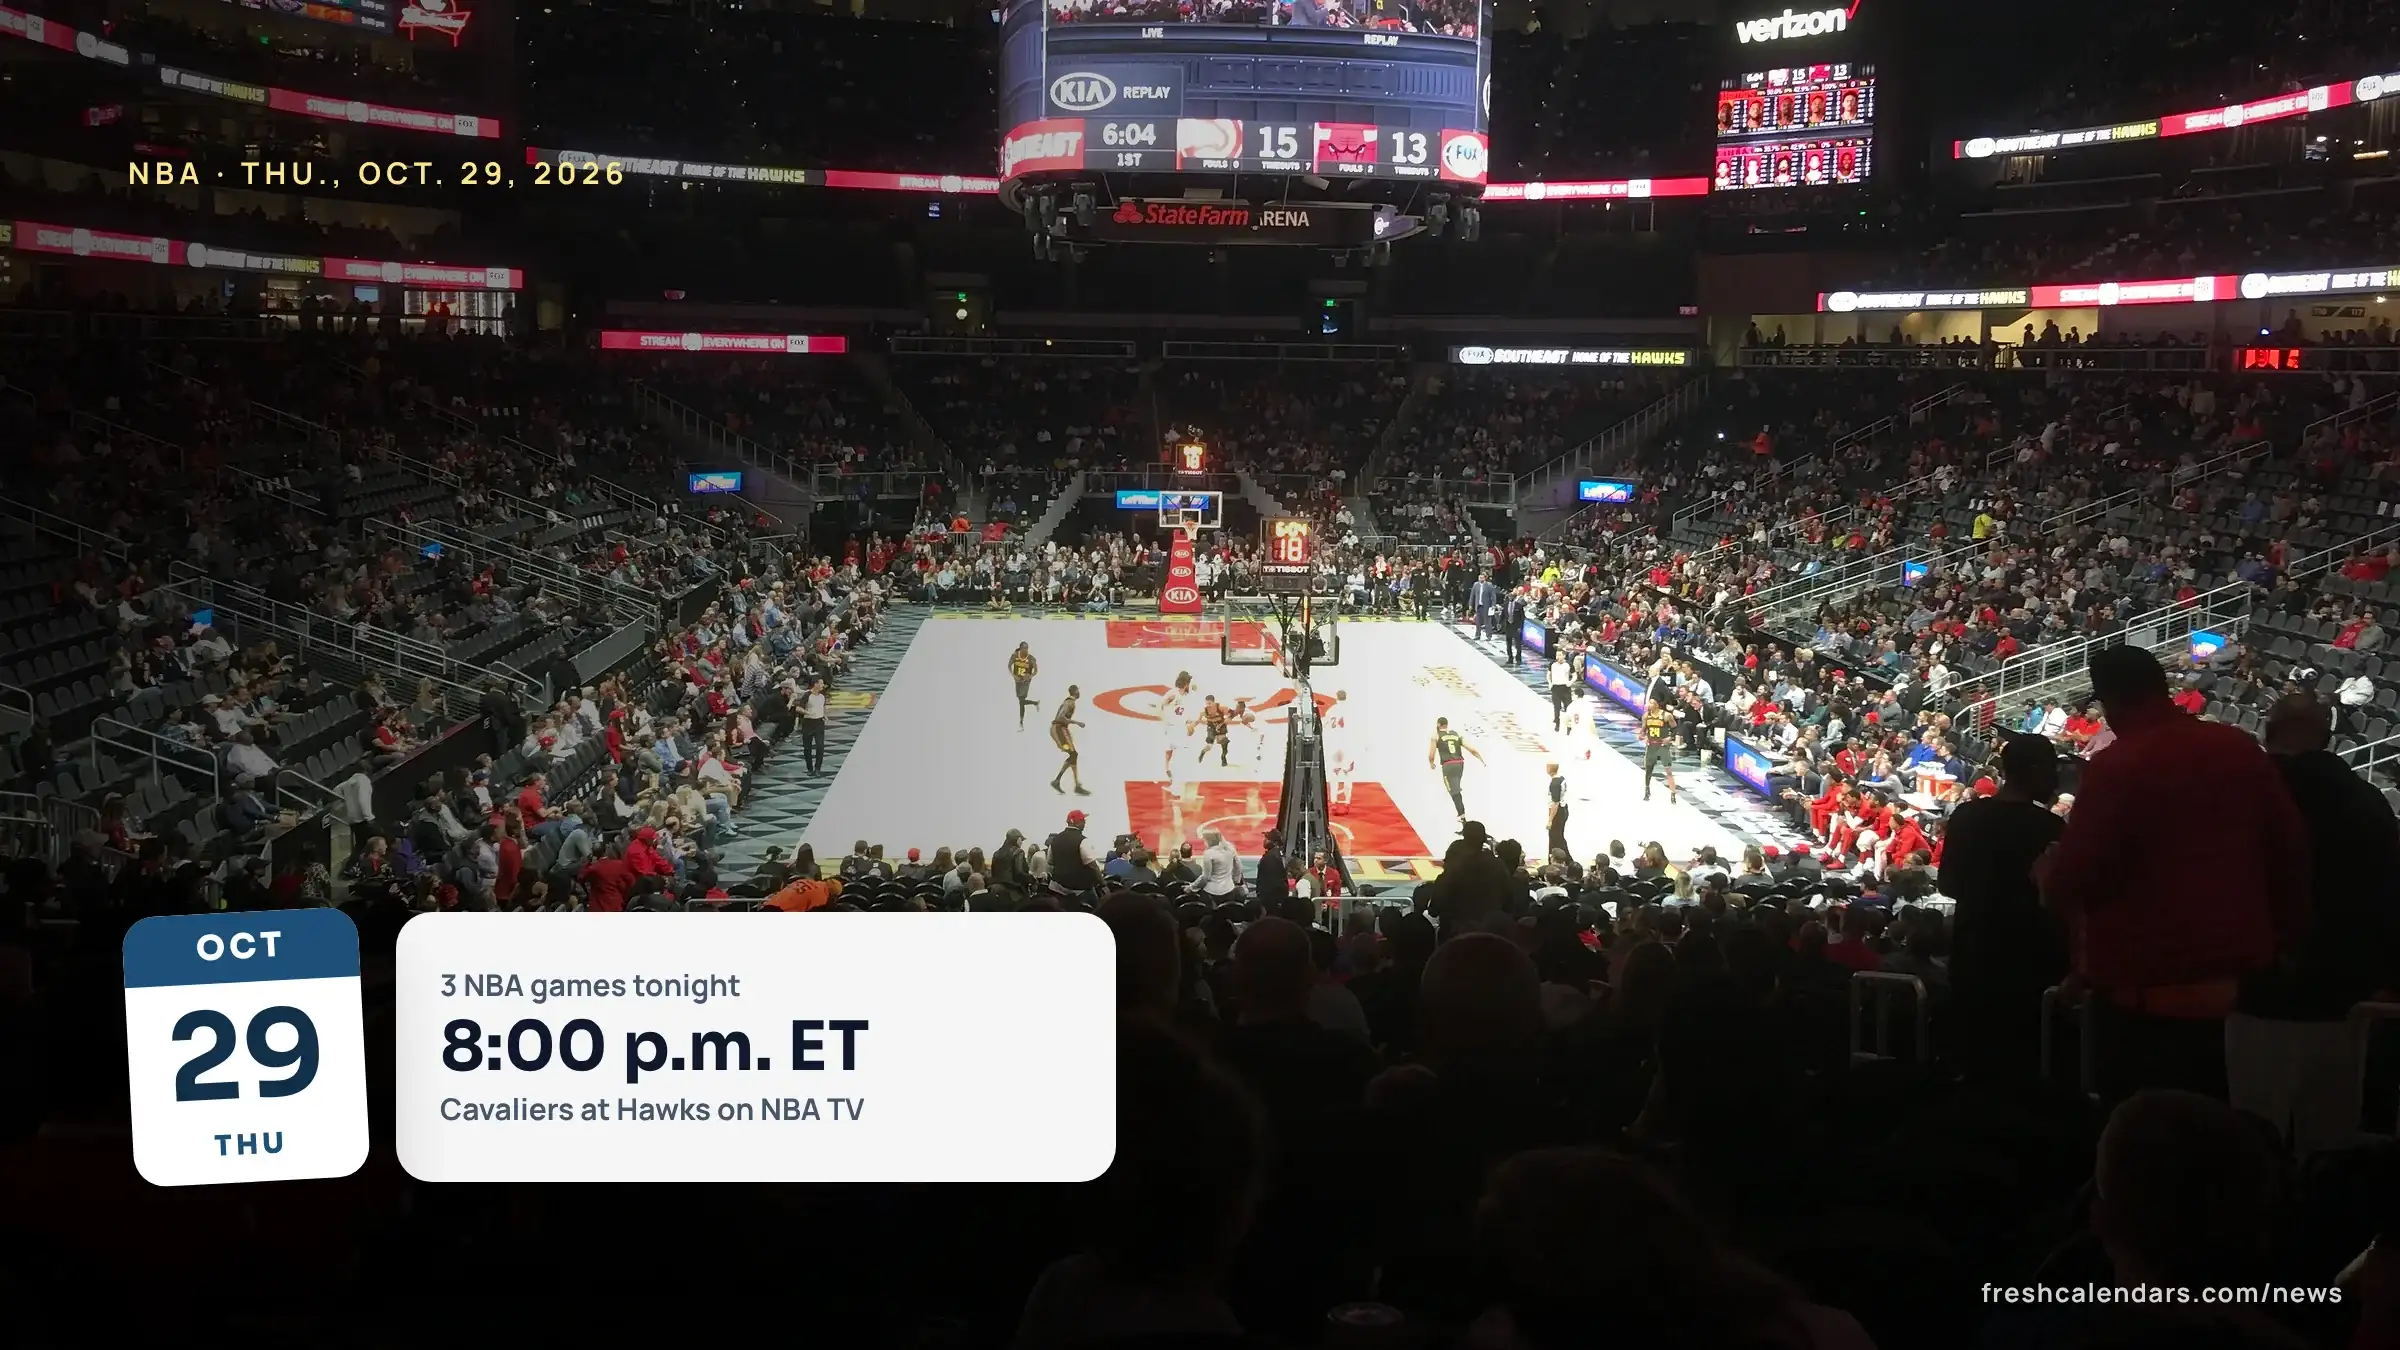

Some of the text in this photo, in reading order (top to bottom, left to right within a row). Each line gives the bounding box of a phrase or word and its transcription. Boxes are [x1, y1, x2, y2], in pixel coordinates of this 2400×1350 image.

[1142, 28, 1163, 38] LIVE
[1736, 9, 1846, 43] verizon
[1364, 34, 1398, 46] REPLAY
[1792, 69, 1806, 80] 15
[1834, 65, 1847, 76] 13
[1060, 81, 1105, 102] KIA
[1123, 86, 1170, 99] REPLAY
[1103, 123, 1156, 146] 6:04
[2112, 122, 2157, 139] HAWKS
[1258, 126, 1298, 159] 15
[1392, 132, 1427, 164] 13
[1117, 153, 1142, 167] 1ST
[1203, 160, 1228, 169] FOULS
[1305, 163, 1312, 171] 7
[748, 167, 805, 183] HAWKS
[1338, 164, 1374, 174] FOULS 2
[1433, 168, 1440, 177] 7
[640, 335, 680, 347] STREAM
[703, 336, 768, 349] EVERYWHERE
[770, 338, 786, 350] ON
[1494, 349, 1569, 364] SOUTHEAST
[1571, 351, 1600, 364] HOME
[1600, 351, 1613, 364] OF
[1612, 351, 1632, 364] THE
[1631, 351, 1686, 365] HAWKS
[1281, 537, 1302, 562] 18
[1276, 565, 1310, 573] TISSOT
[1170, 590, 1193, 601] KIA
